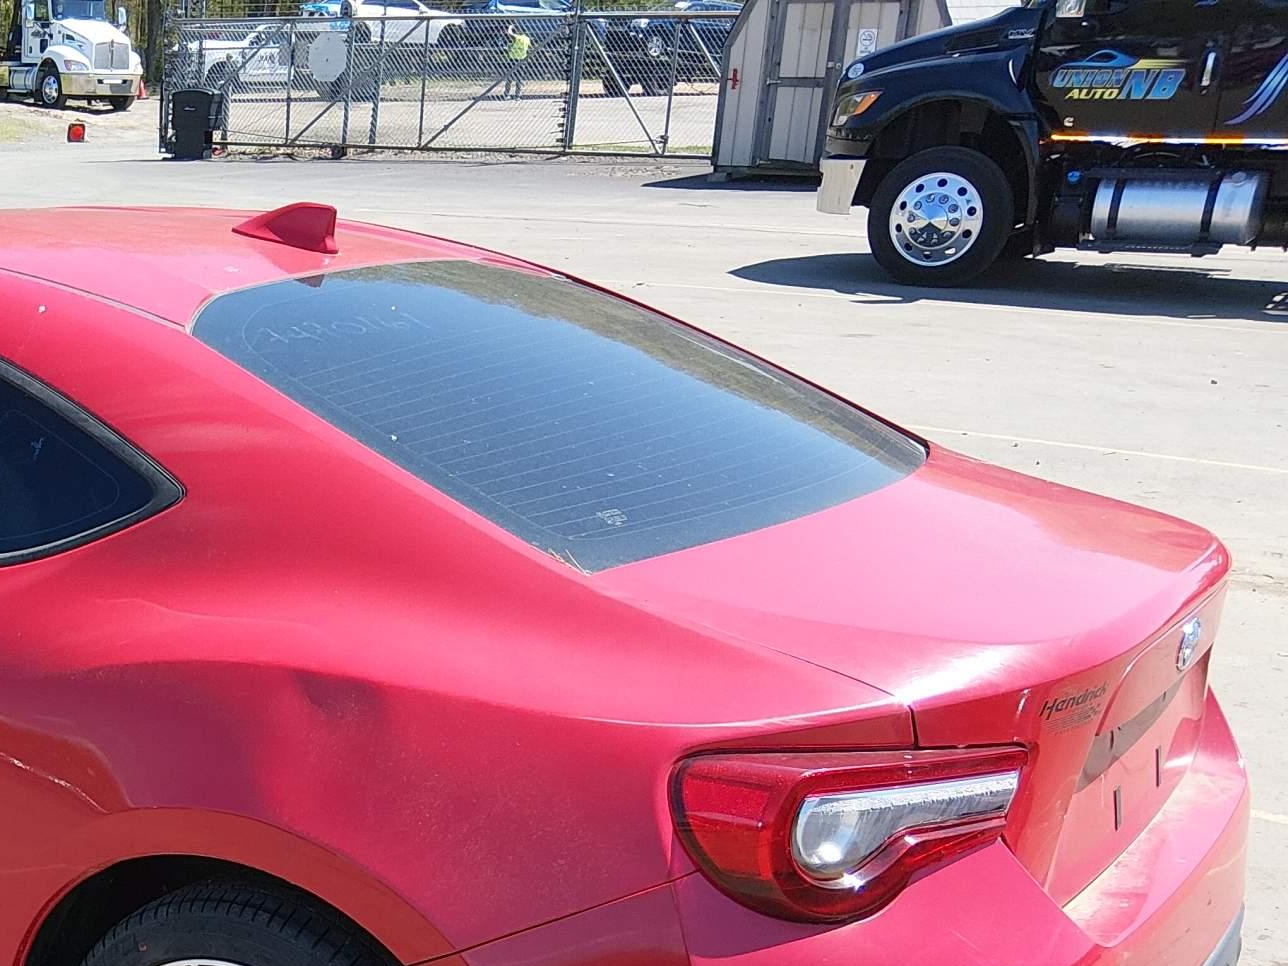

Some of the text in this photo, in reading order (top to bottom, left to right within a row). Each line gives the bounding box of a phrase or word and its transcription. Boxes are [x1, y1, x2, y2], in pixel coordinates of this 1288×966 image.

[1053, 69, 1186, 100] UNION NB
[1064, 88, 1119, 100] AUTO
